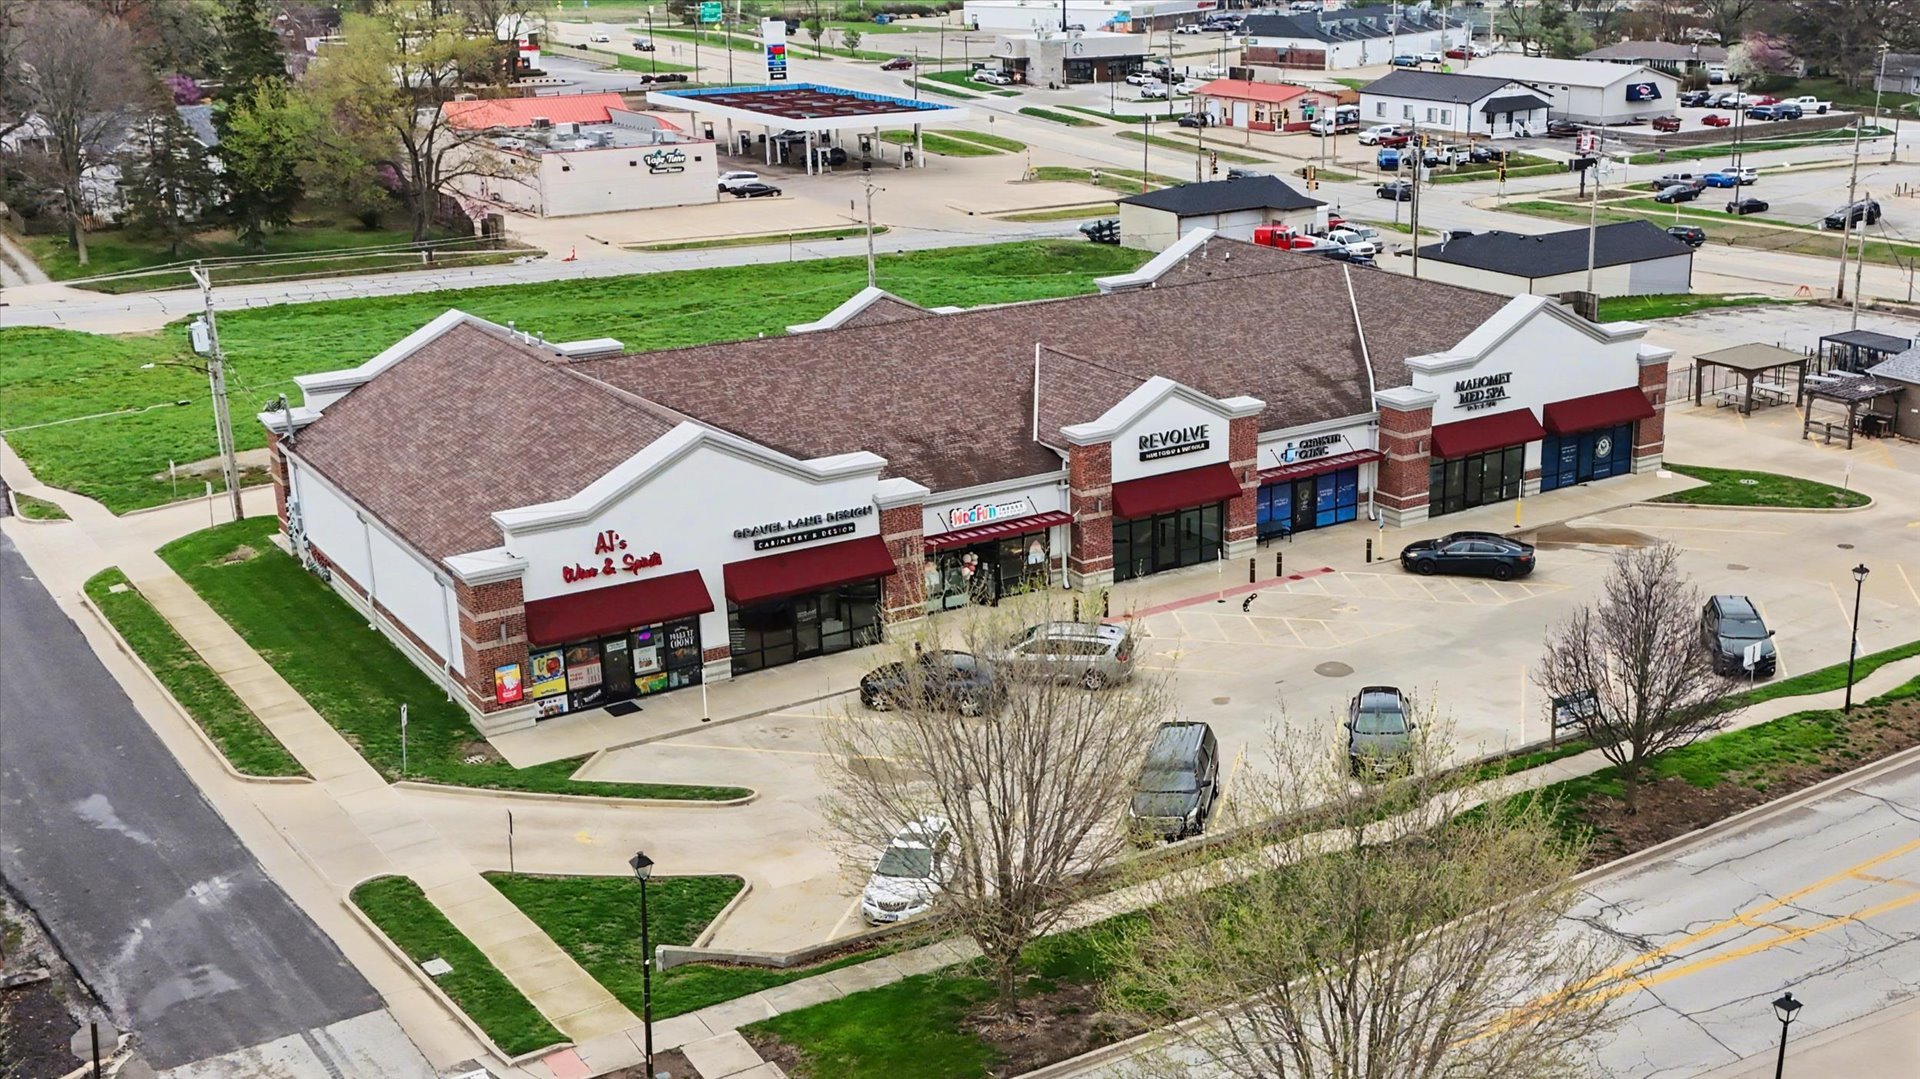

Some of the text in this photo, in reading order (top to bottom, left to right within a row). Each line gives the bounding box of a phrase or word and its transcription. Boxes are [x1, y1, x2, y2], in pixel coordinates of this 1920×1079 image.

[1454, 372, 1512, 392] MAHOMET
[1459, 385, 1505, 404] MED SPA
[1139, 424, 1209, 450] REVOLVE
[733, 505, 873, 539] GRAVEL LANE DESIGN
[595, 530, 628, 555] AJ's
[758, 533, 809, 549] CABINETRY
[821, 525, 854, 537] DESIGN
[602, 557, 617, 575] &
